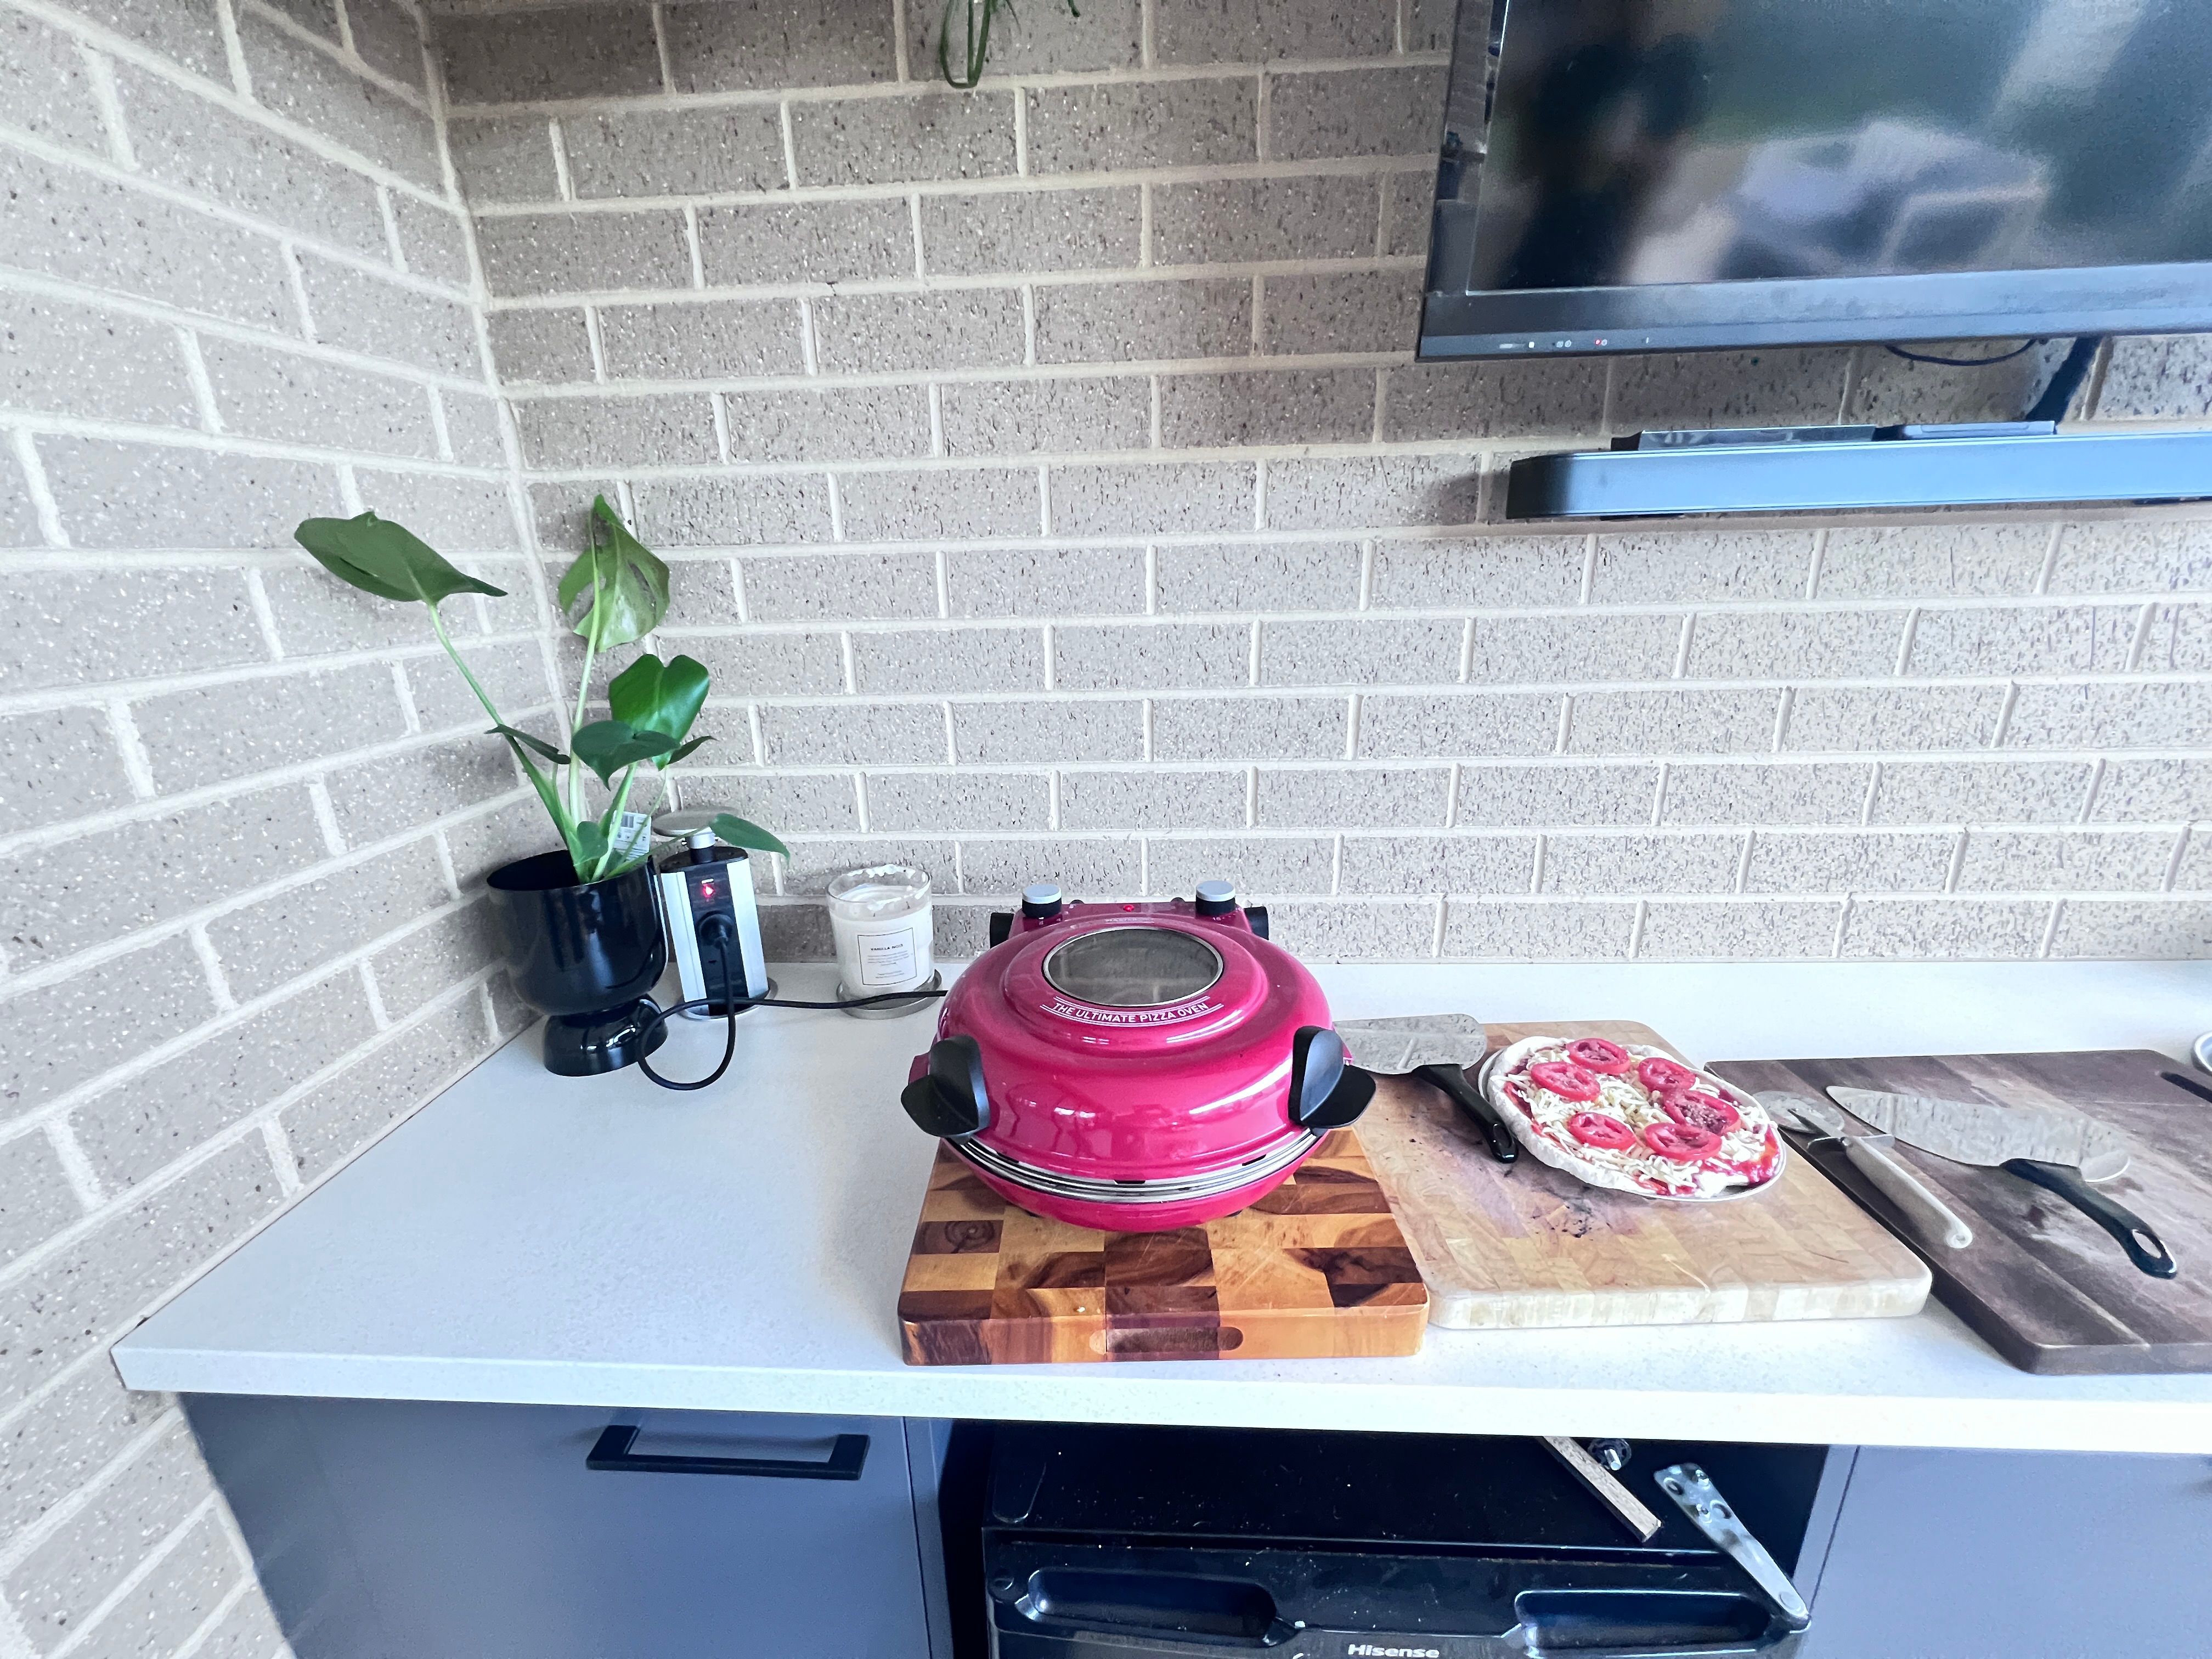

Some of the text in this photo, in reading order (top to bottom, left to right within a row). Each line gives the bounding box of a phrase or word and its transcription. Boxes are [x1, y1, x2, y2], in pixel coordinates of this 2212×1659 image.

[1054, 1002, 1210, 1023] THE ULTIMATE PIZZA OVEN
[1347, 1644, 1440, 1658] Hisense
